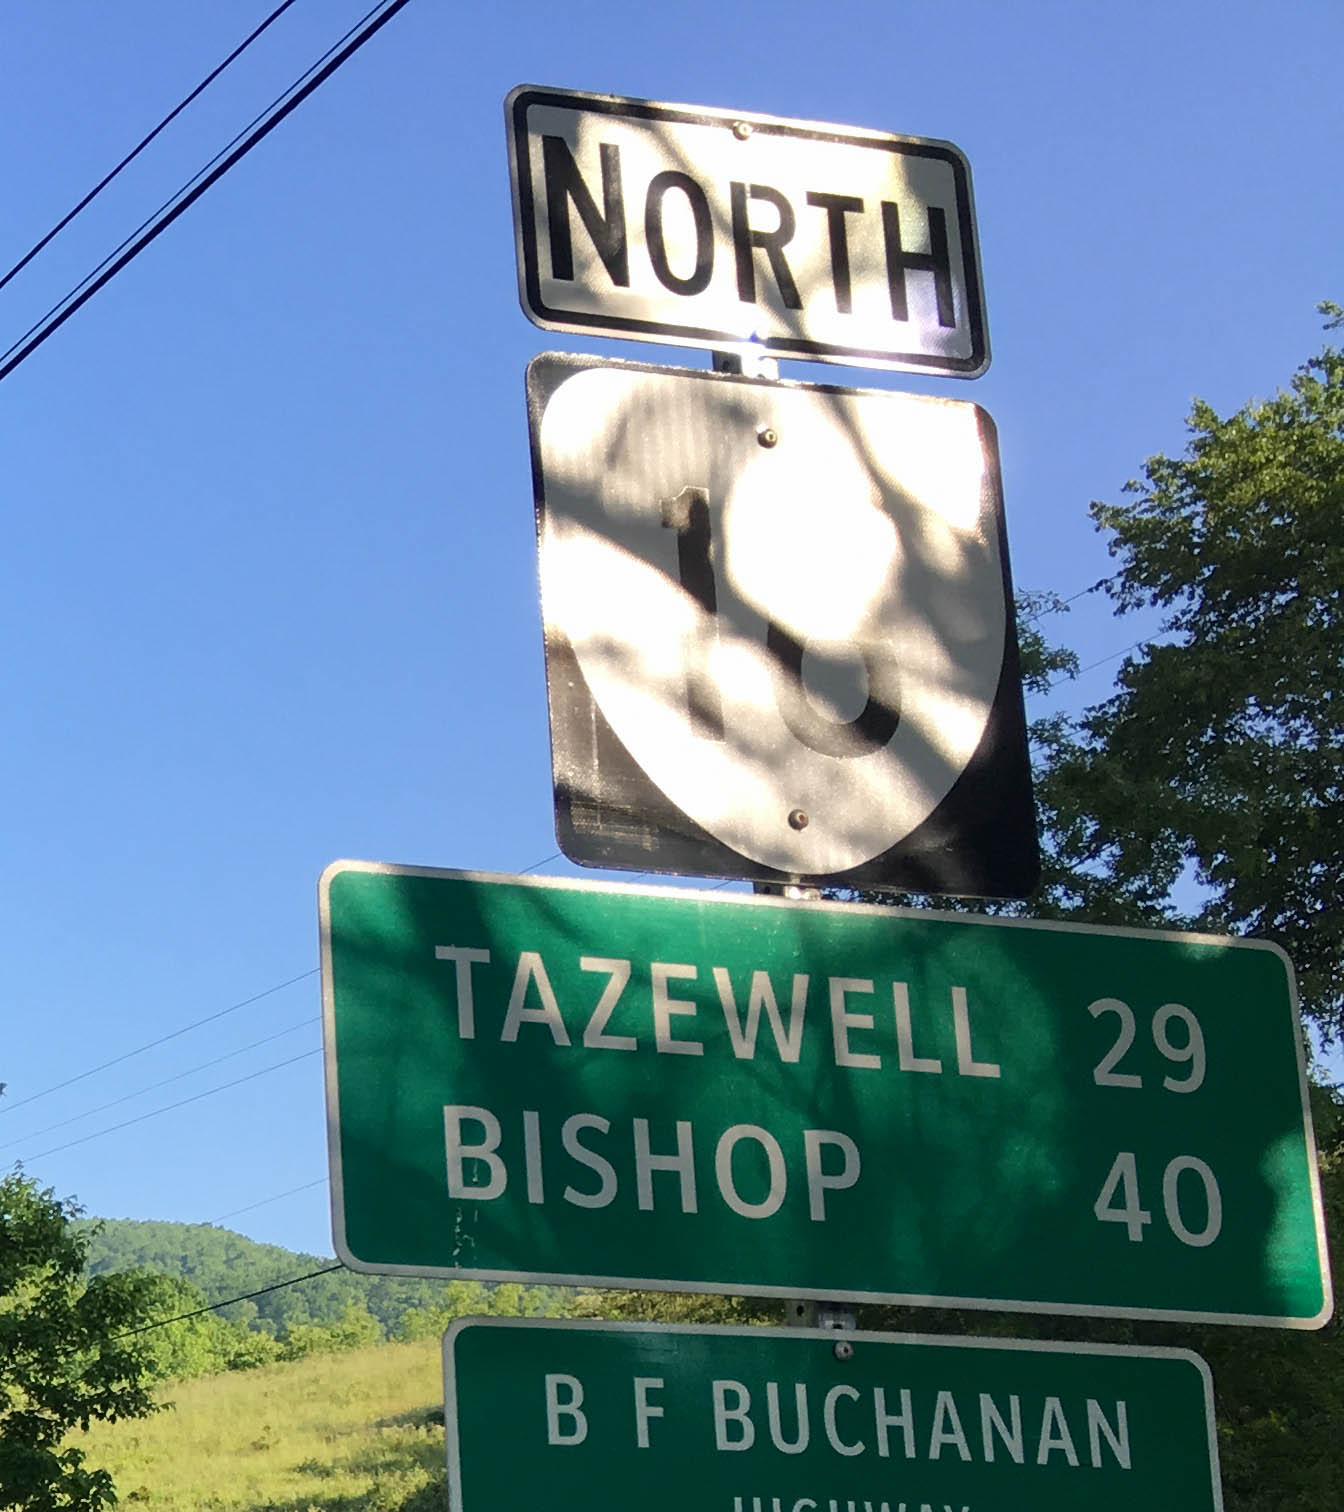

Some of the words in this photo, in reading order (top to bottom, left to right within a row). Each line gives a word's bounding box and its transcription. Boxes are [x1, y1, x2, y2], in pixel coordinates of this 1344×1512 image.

[541, 134, 959, 329] NORTH
[434, 944, 1002, 1079] TAZEWELL
[1086, 996, 1209, 1094] 29
[442, 1104, 863, 1222] BISHOP
[1093, 1150, 1224, 1249] 40
[545, 1372, 588, 1447] B
[634, 1376, 666, 1449] F
[713, 1378, 1133, 1470] BUCHANAN
